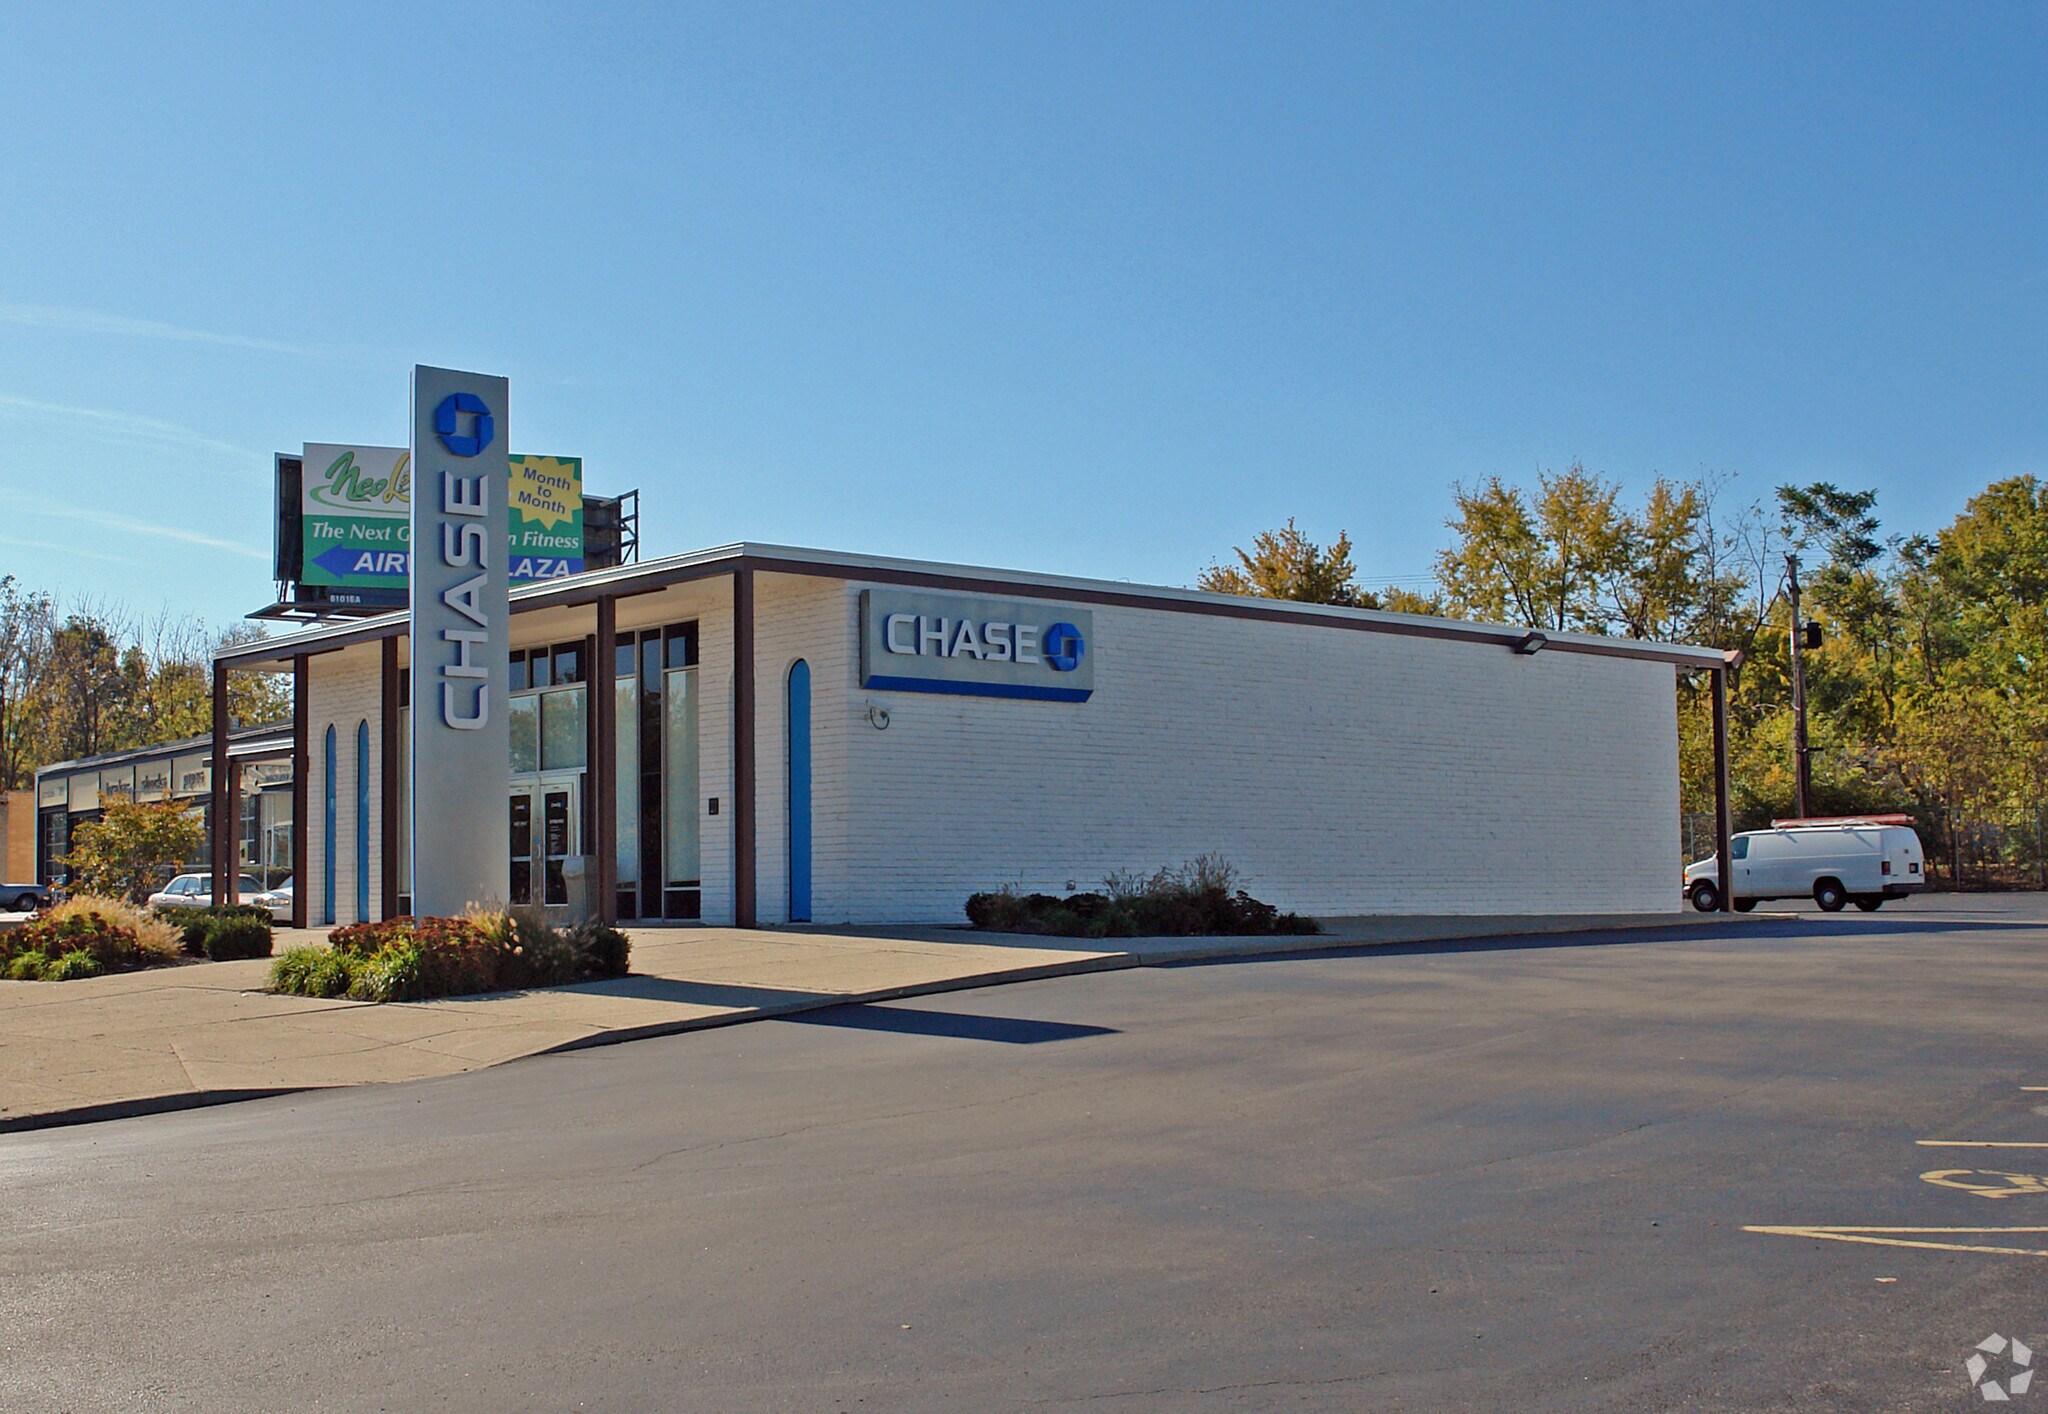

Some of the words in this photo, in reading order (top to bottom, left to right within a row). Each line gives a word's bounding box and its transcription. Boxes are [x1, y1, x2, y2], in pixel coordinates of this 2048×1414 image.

[325, 451, 410, 504] NeoL
[523, 466, 571, 491] Month
[518, 490, 566, 514] Month
[537, 485, 552, 498] to
[312, 521, 344, 539] The
[349, 523, 392, 541] Next
[522, 531, 579, 549] Fitness
[353, 551, 411, 573] AIR
[443, 470, 489, 730] CHASE
[885, 613, 1040, 665] CHASE
